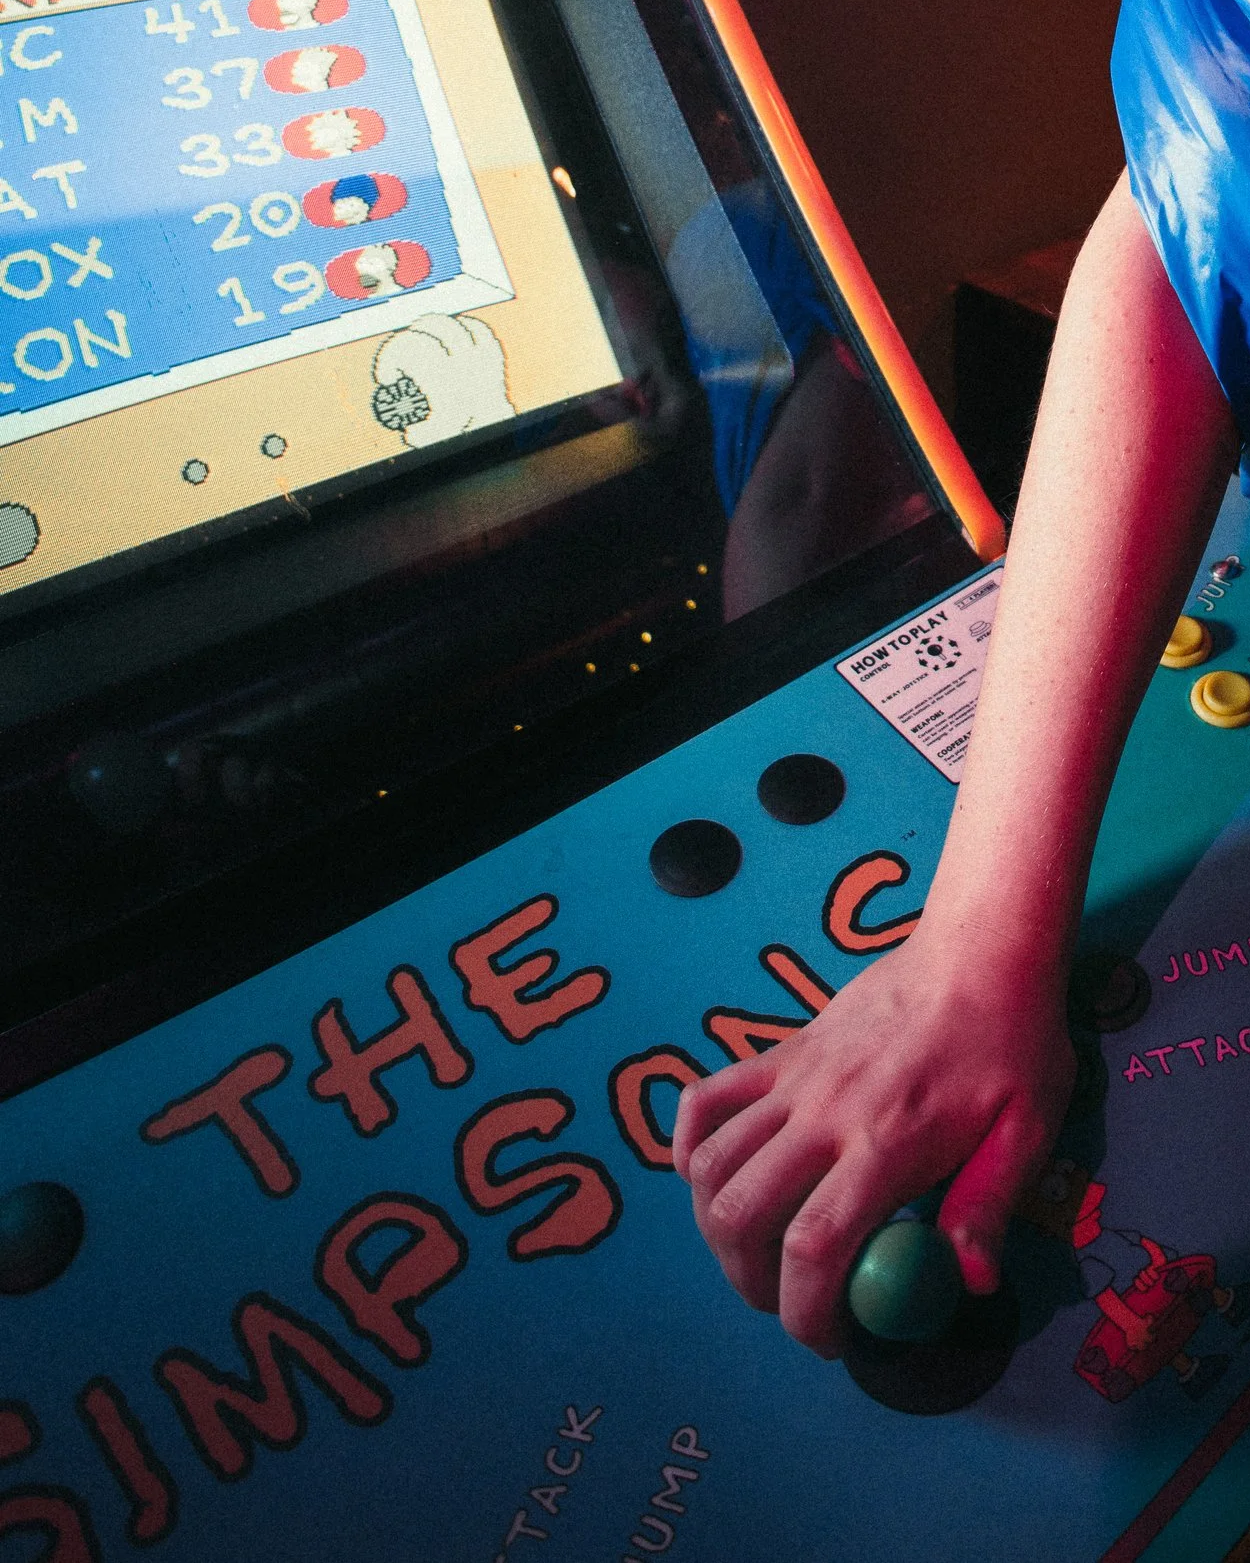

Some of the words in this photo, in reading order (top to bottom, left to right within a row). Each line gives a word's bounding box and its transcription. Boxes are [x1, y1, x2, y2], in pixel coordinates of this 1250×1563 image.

[161, 57, 260, 111] 37
[177, 123, 283, 179] 33
[192, 190, 302, 253] 20
[217, 260, 328, 327] 19
[850, 645, 890, 676] HOW
[887, 631, 913, 654] TO
[909, 609, 948, 640] PLAY
[860, 660, 891, 684] CONTROL
[911, 709, 945, 734] WEAPONS
[140, 893, 610, 1198] THE
